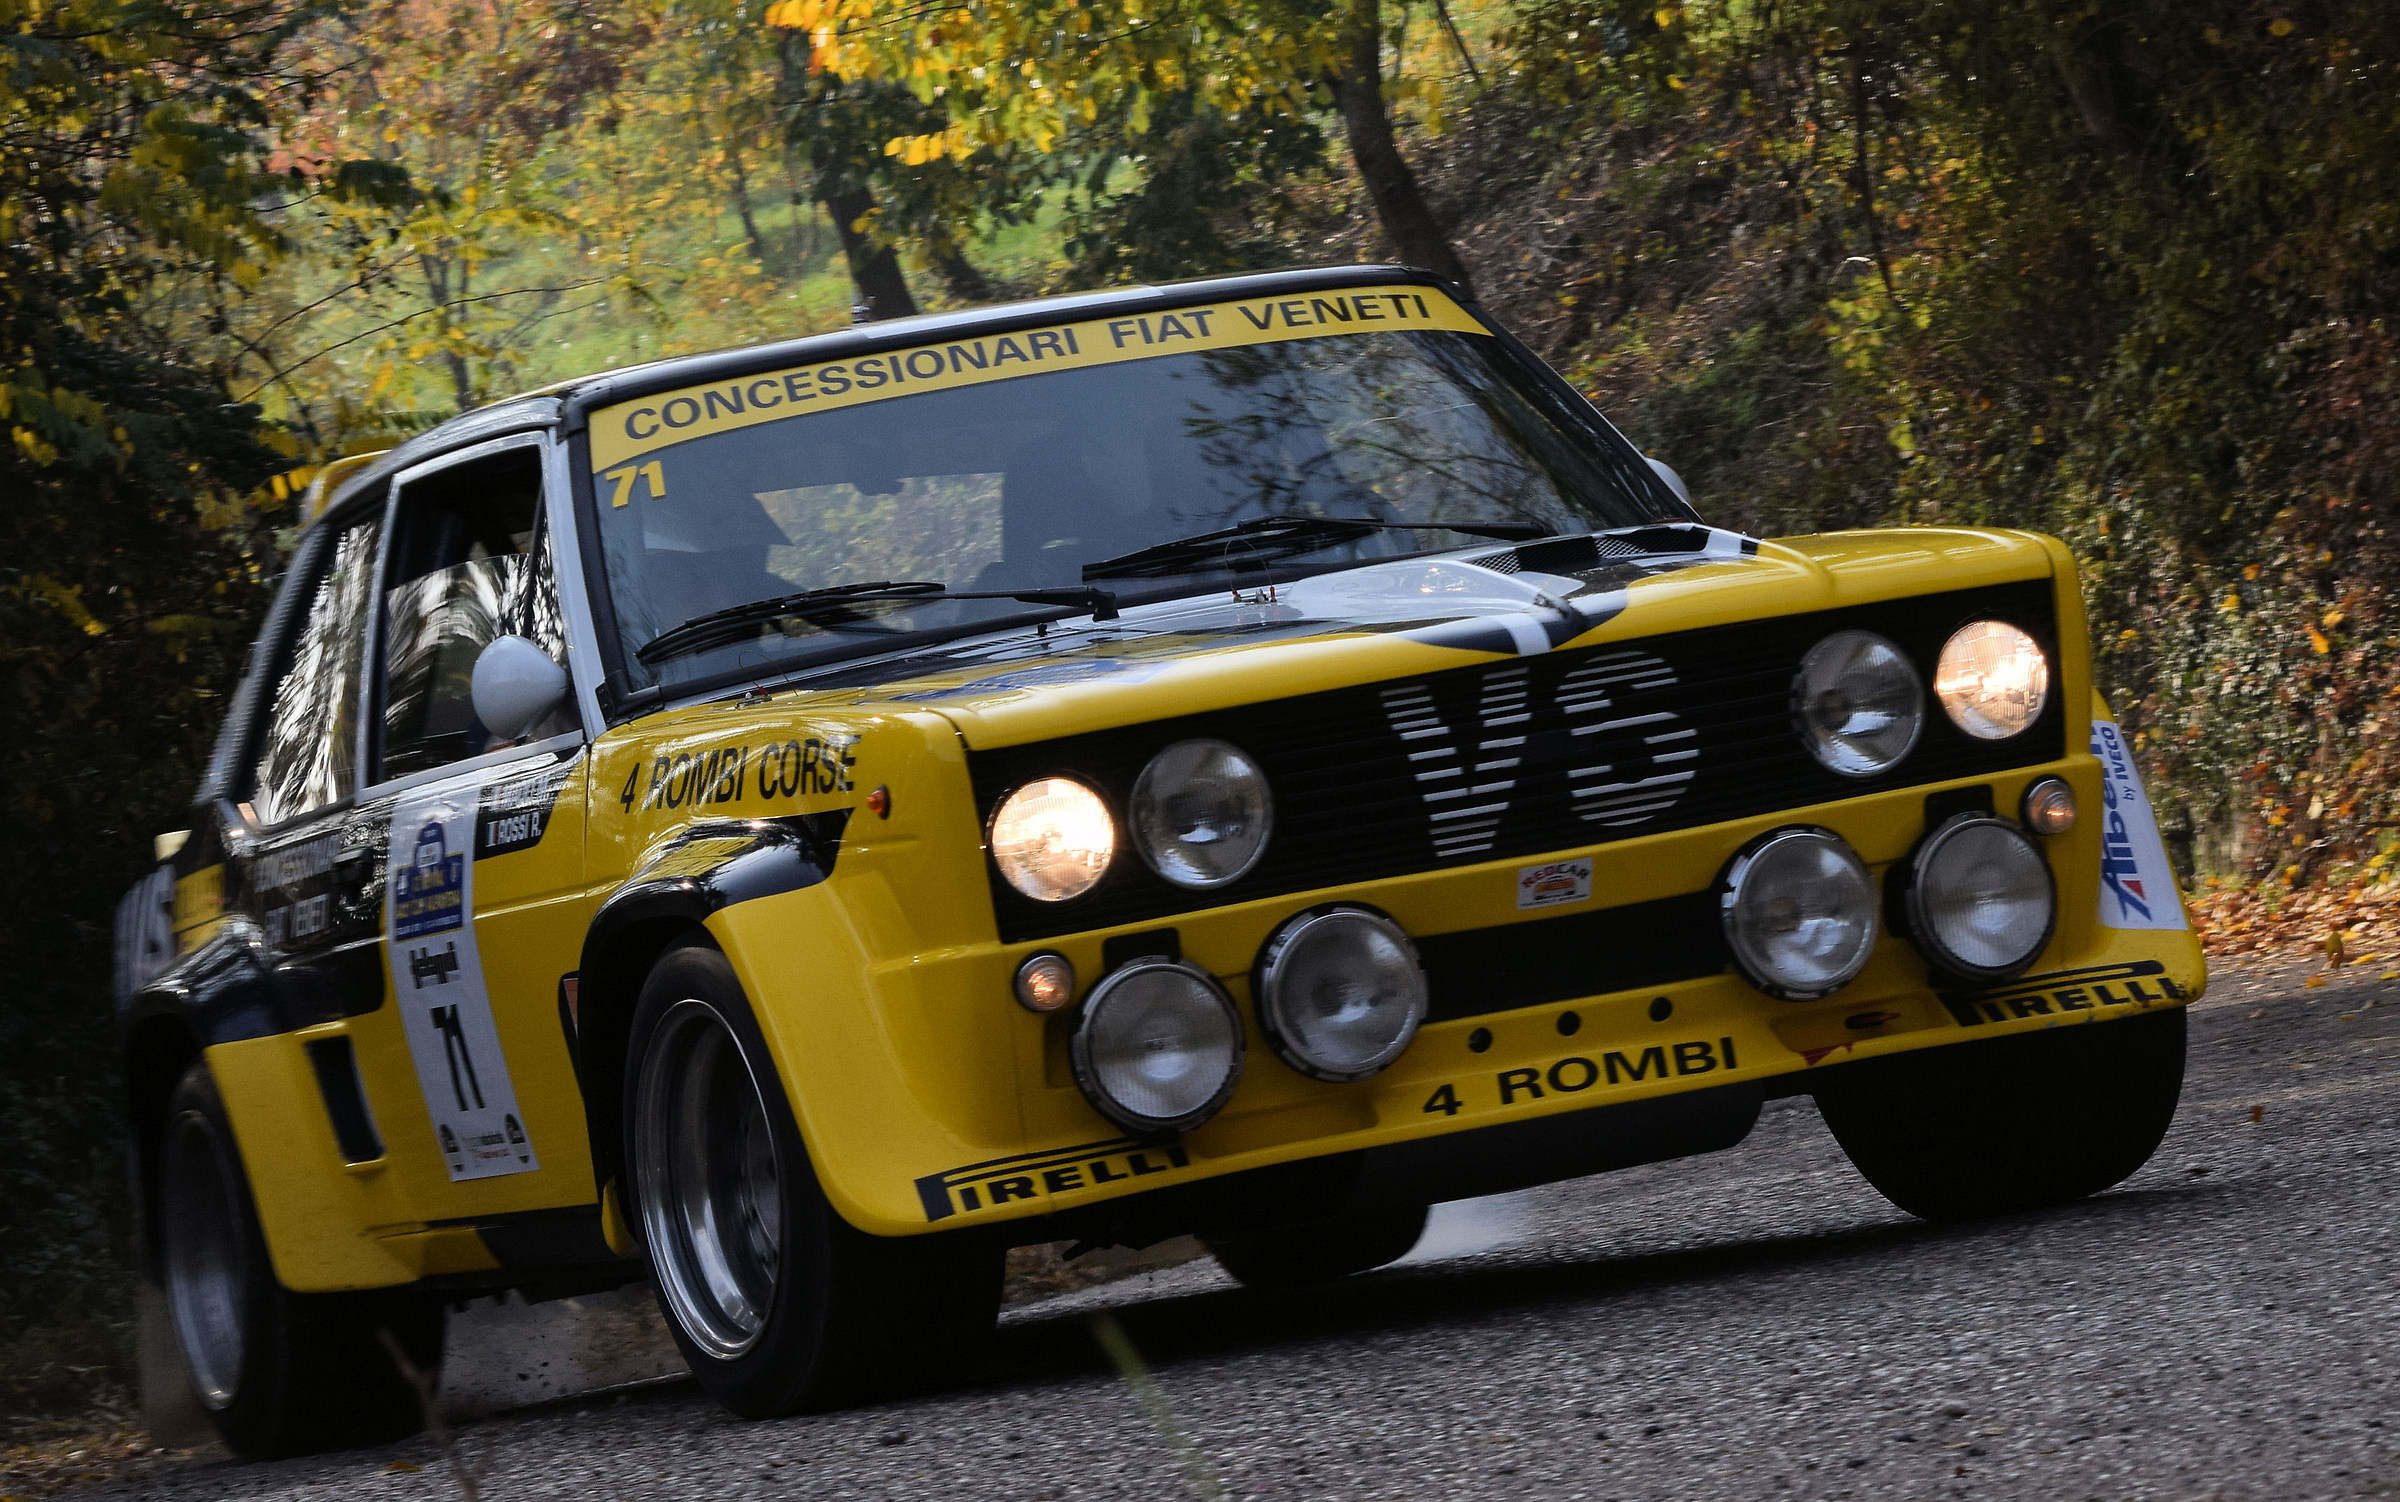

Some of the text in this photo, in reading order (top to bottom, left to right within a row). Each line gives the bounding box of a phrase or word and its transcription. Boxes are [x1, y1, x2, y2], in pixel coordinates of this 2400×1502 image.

[624, 293, 1431, 441] CONCESSIONARI FIAT VENETI
[605, 460, 667, 509] 71
[620, 762, 641, 814] 4
[642, 747, 748, 811] ROMBI
[758, 735, 862, 800] CORSE
[1379, 651, 1699, 858] VS
[2101, 726, 2136, 801] by IVECO
[498, 813, 530, 844] ROSSI
[1521, 863, 1590, 888] REDCAR
[1936, 960, 2180, 1027] PIRELLI
[430, 1003, 485, 1112] 71
[1422, 1036, 1737, 1116] 4 ROMBI
[914, 1130, 1191, 1223] PIRELLI
